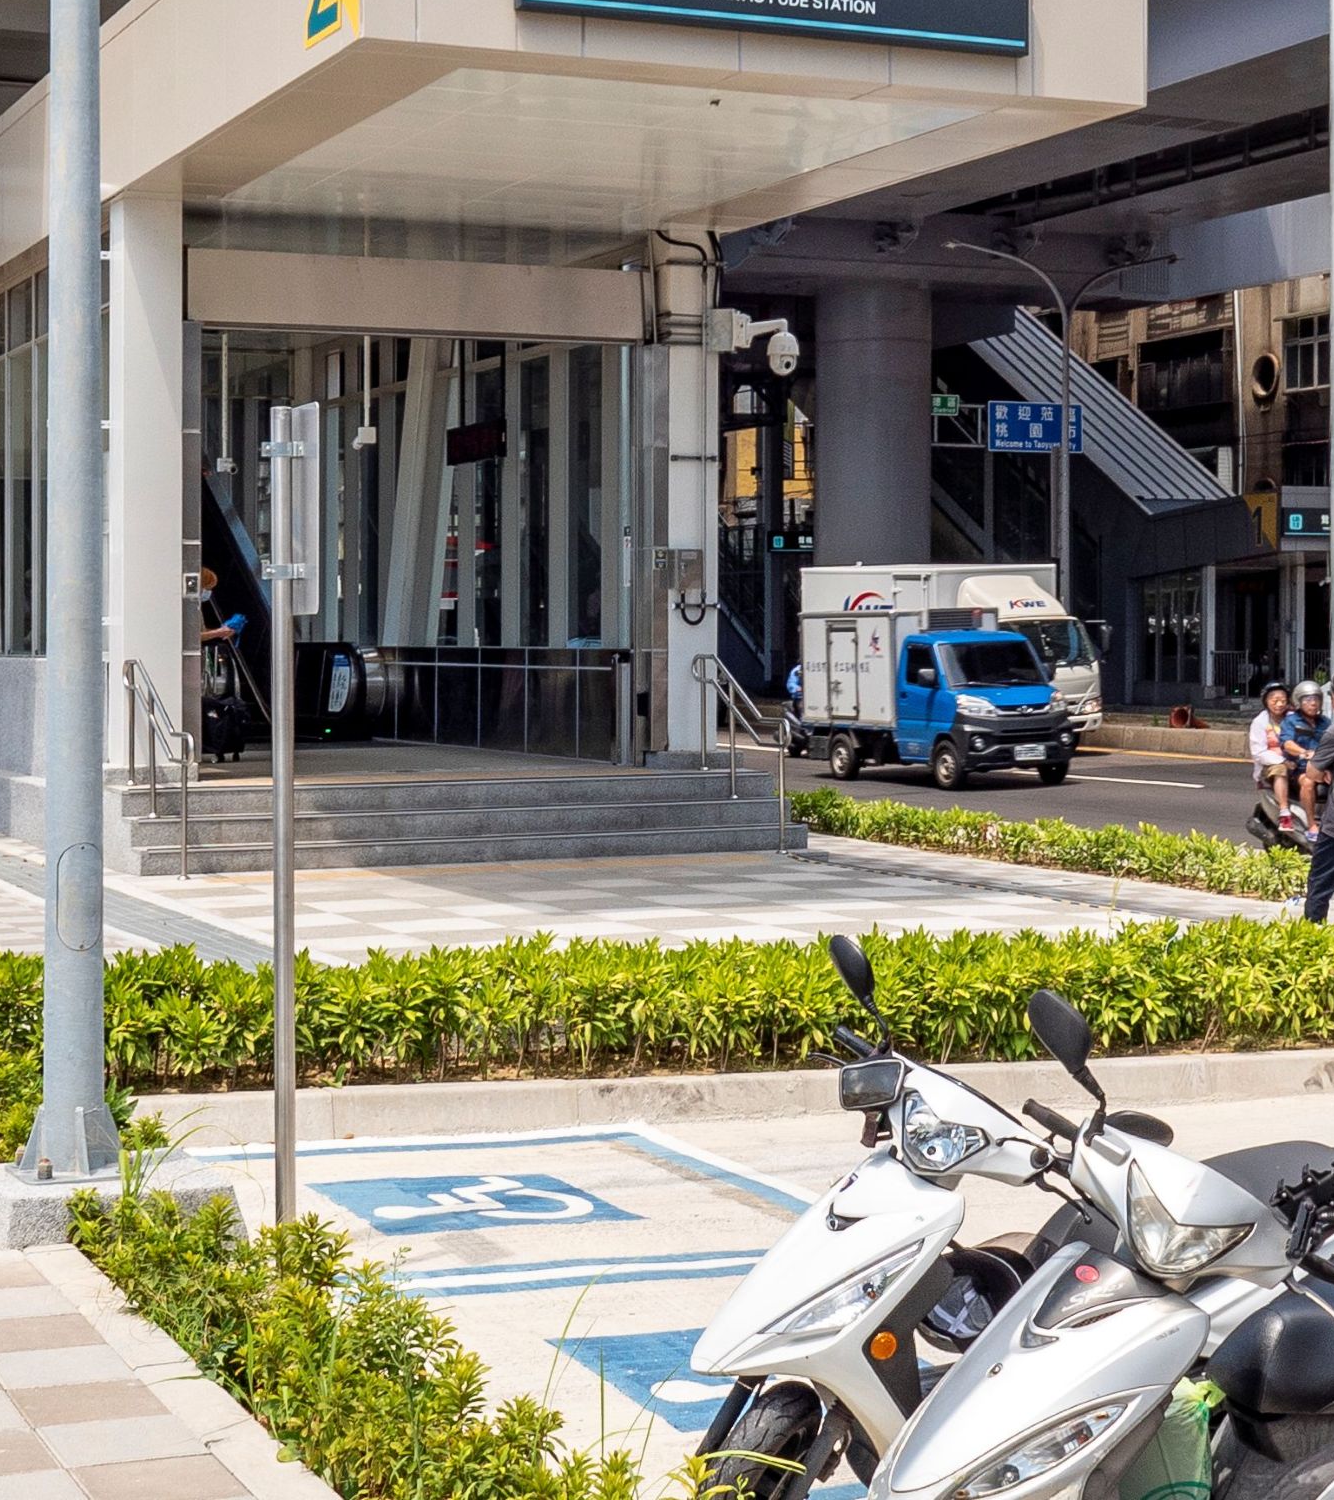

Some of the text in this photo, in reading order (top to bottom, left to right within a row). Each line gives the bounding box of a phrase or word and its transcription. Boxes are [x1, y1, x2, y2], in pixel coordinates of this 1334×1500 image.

[995, 439, 1024, 448] Welcome
[1025, 440, 1032, 448] to
[1252, 506, 1263, 545] 1
[1009, 598, 1046, 609] KWE
